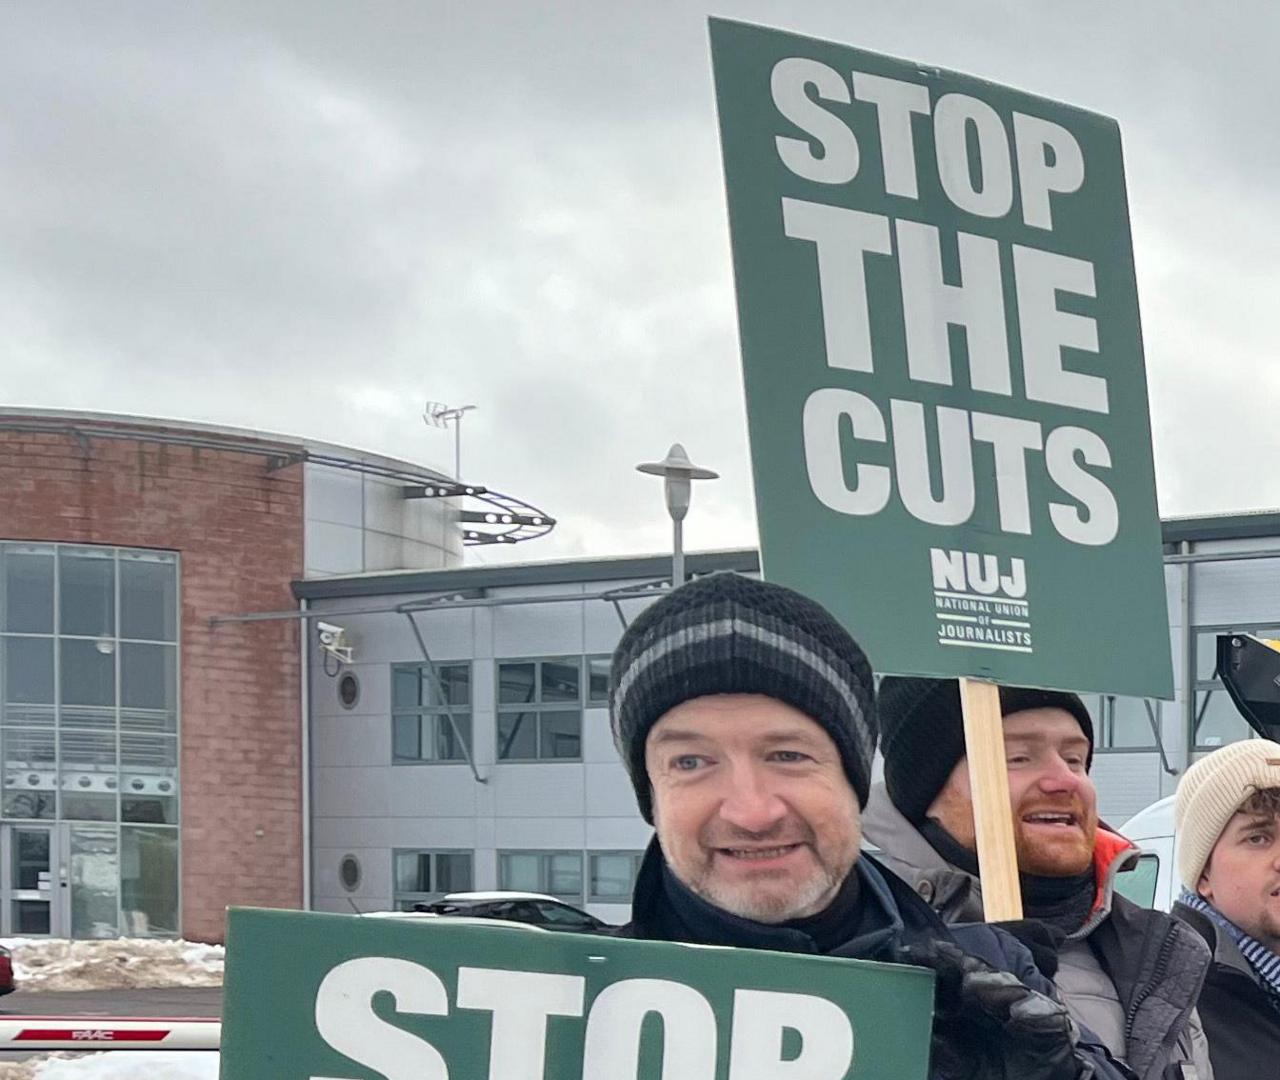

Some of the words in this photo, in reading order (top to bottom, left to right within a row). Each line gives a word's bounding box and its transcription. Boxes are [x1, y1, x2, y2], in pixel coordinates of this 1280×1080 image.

[770, 57, 1085, 231] STOP
[781, 197, 1109, 414] THE
[803, 388, 1119, 546] CUTS
[930, 547, 1027, 598] NUJ
[935, 597, 991, 613] NATIONAL
[994, 602, 1029, 617] UNION
[978, 615, 990, 625] OF
[938, 624, 1031, 645] JOURNALISTS
[72, 1030, 114, 1040] FAAC
